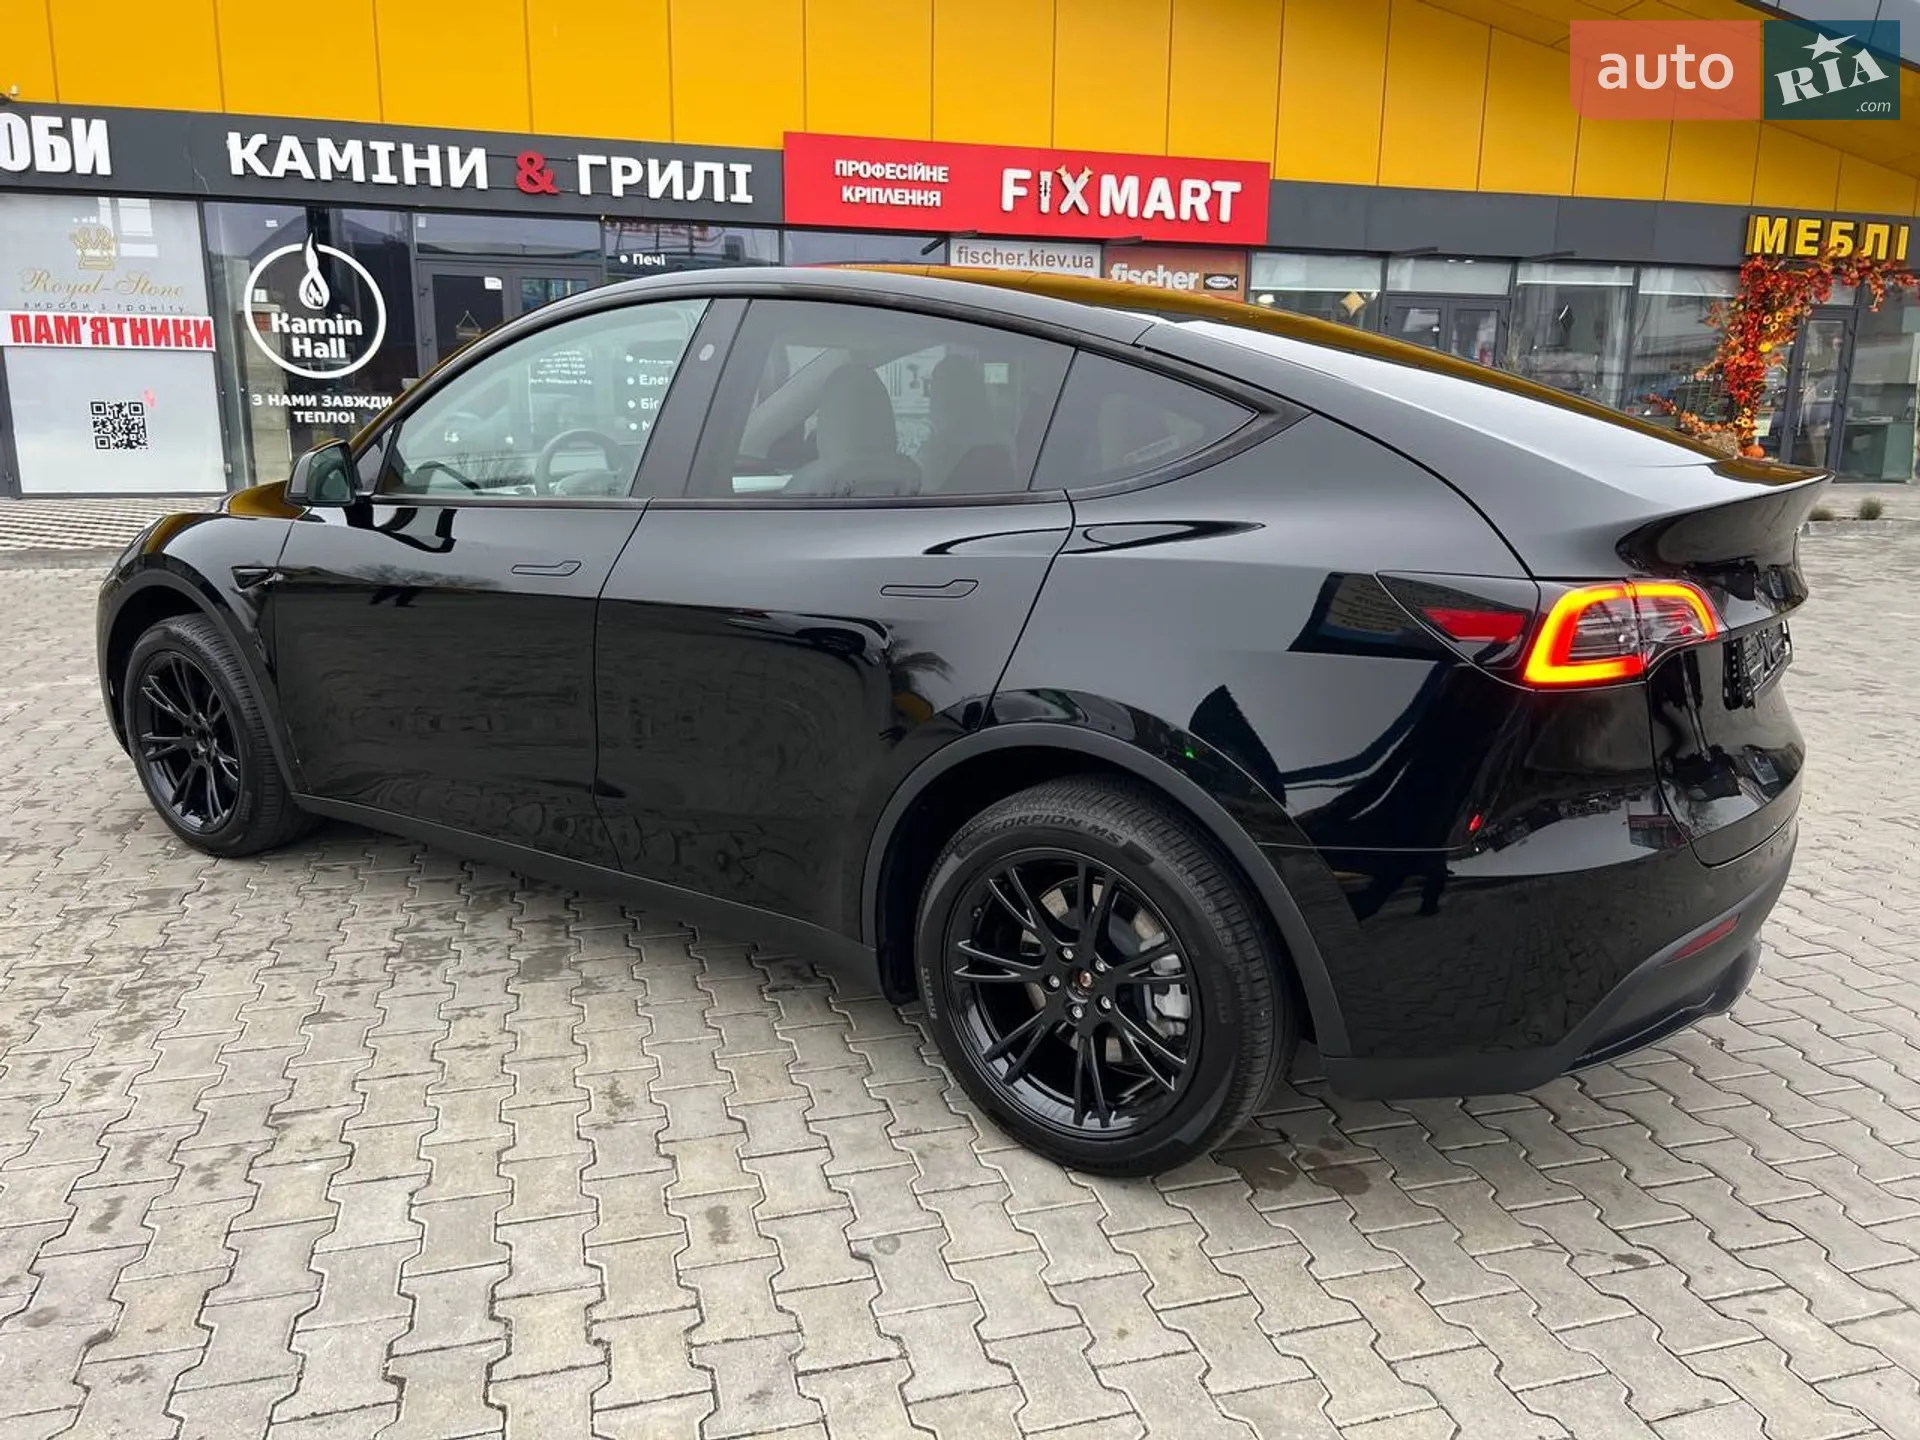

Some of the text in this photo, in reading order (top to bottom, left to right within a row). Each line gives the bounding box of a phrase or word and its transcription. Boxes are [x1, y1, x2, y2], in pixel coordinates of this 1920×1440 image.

[0, 112, 112, 175] ОБИ
[226, 131, 754, 204] КАМІНИ & ГРИЛІ
[834, 158, 949, 183] ПРОФЕСІЙНЕ
[842, 184, 941, 207] КРІПЛЕННЯ
[1747, 215, 1910, 261] МЕБЛІ
[633, 253, 666, 266] Печі
[956, 246, 1094, 269] fischer.kiev.ua
[1110, 263, 1200, 291] fischer
[10, 314, 214, 348] ПАМ'ЯТНИКИ
[271, 312, 363, 335] Kamin
[292, 337, 346, 358] Hall
[252, 395, 393, 410] З НАМИ ЗАВЖДИ
[294, 411, 356, 424] ТЕПЛО!
